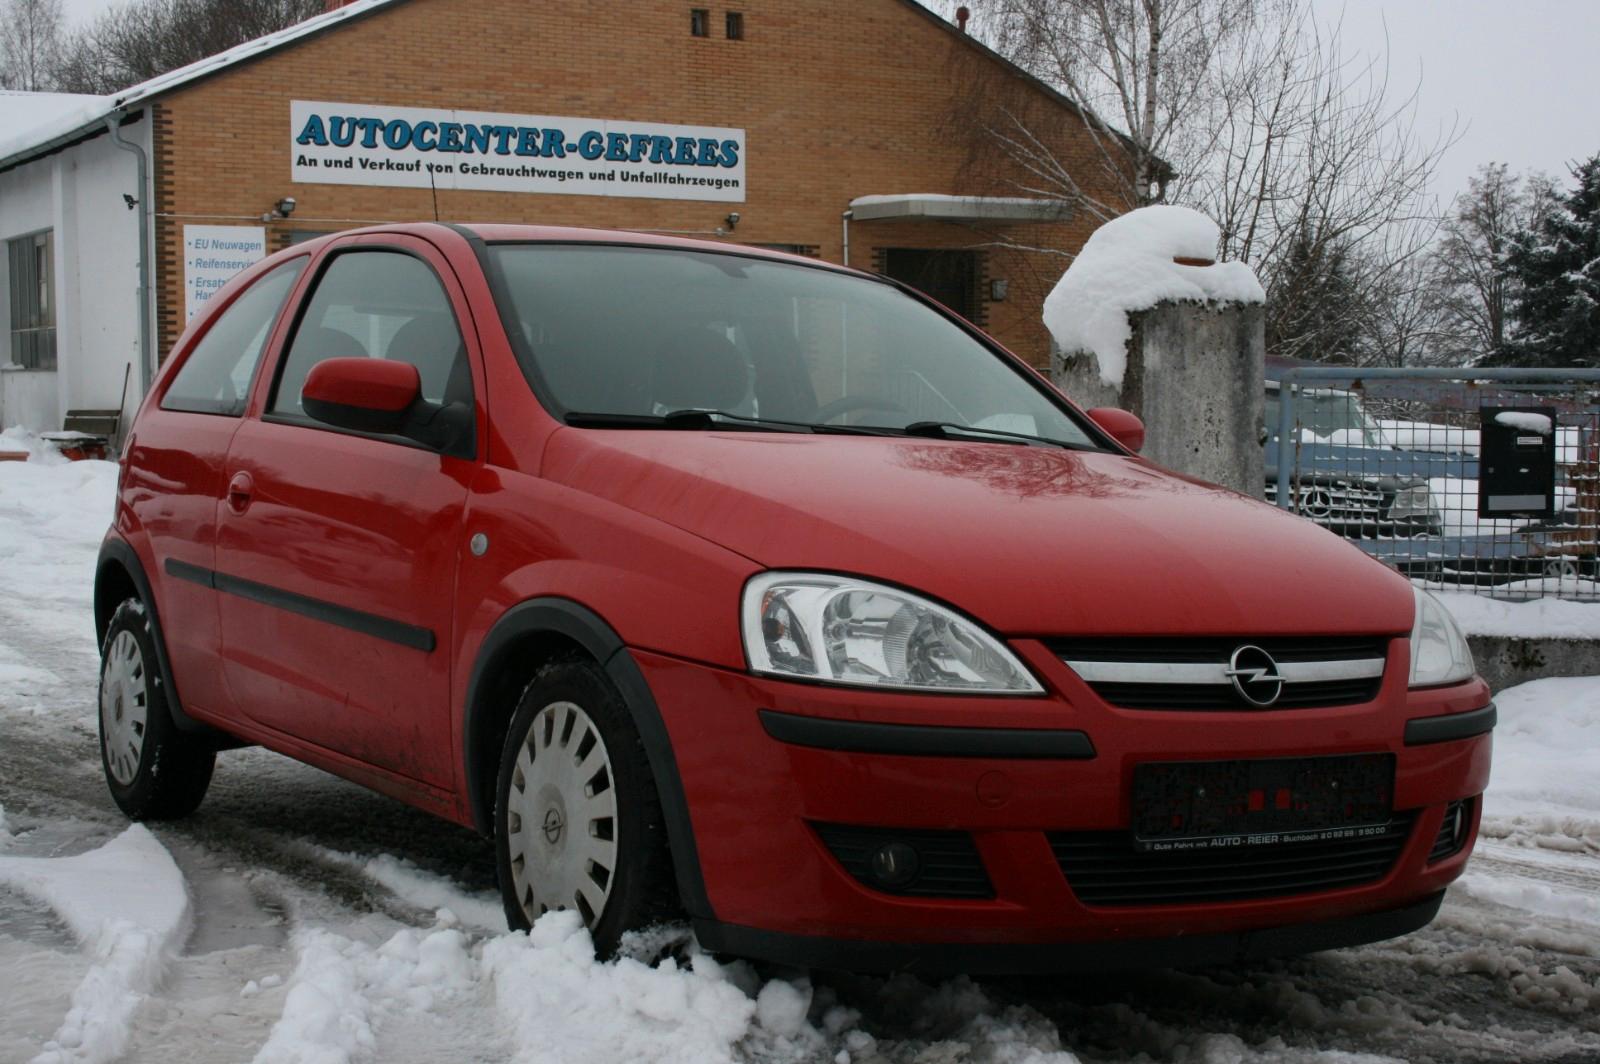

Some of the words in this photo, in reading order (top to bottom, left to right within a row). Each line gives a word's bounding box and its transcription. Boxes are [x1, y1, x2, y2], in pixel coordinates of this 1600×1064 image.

[296, 114, 740, 168] AUTOCENTER-GEFREES
[296, 154, 318, 167] An
[323, 156, 354, 169] und
[358, 158, 421, 173] Verkauf
[426, 163, 453, 174] von
[459, 162, 584, 182] Gebrauchtwagen
[589, 170, 615, 182] und
[620, 171, 740, 190] Unfallfahrzeugen
[194, 239, 210, 250] EU
[211, 240, 262, 253] Neuwagen
[1210, 836, 1241, 847] AUTO
[1247, 834, 1279, 845] REIER
